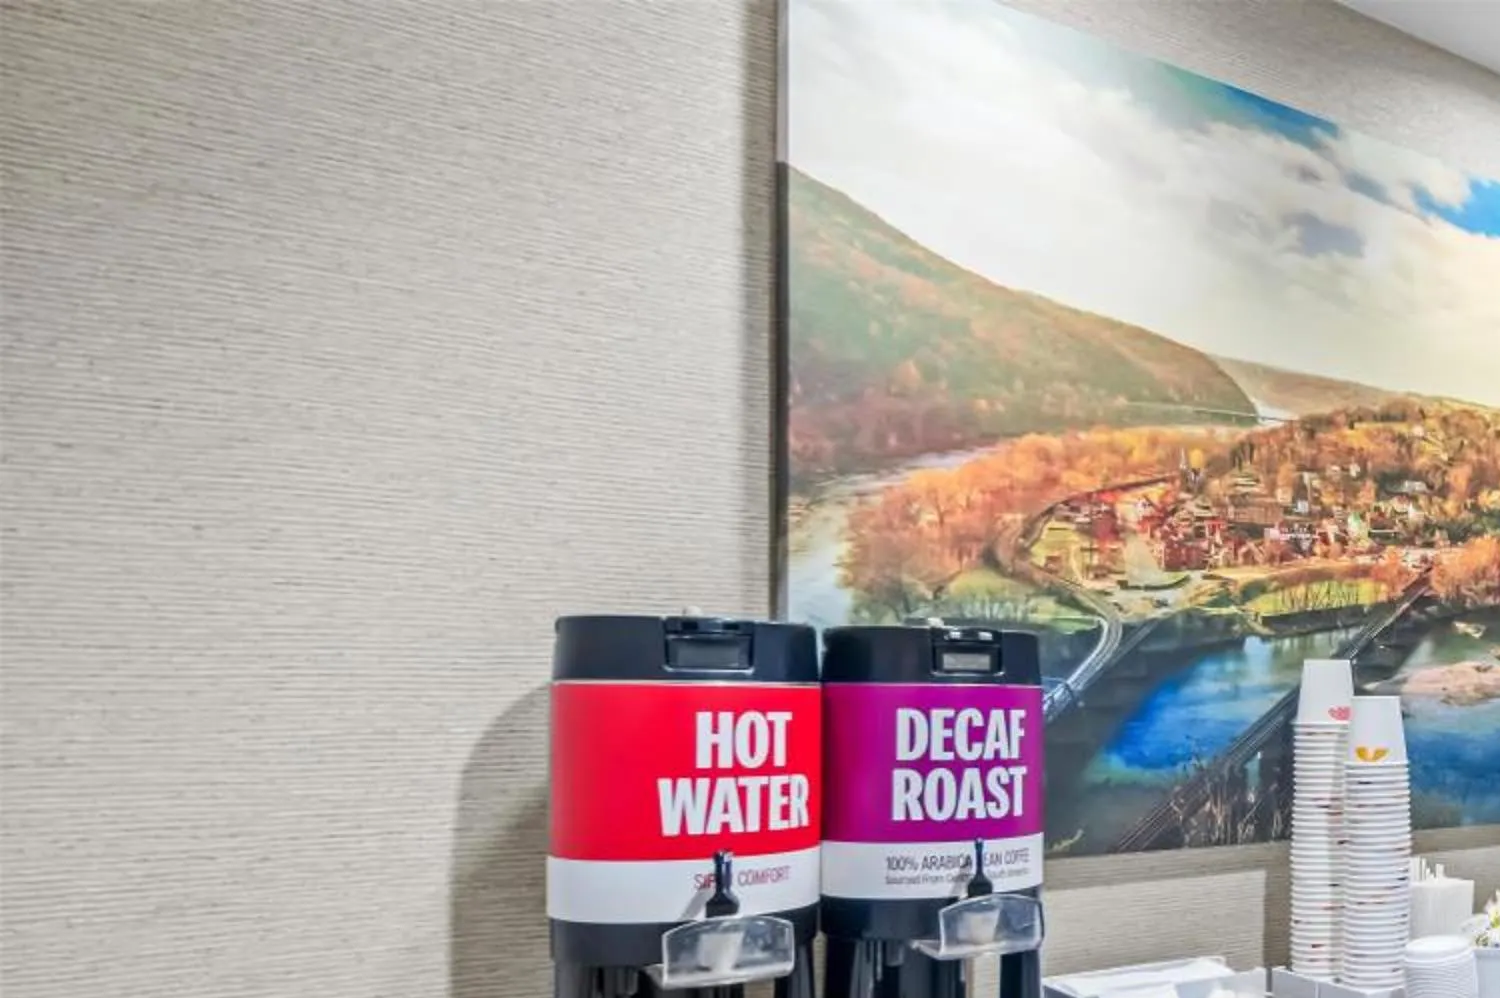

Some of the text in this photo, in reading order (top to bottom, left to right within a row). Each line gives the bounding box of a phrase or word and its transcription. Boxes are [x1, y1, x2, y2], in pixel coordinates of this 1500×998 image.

[696, 711, 792, 769] HOT
[895, 707, 1026, 762] DECAF
[658, 773, 810, 837] WATER
[892, 766, 1027, 823] ROAST
[737, 865, 790, 887] COMFORT
[886, 855, 918, 871] 100%
[920, 853, 972, 870] ARABICA
[983, 850, 1002, 867] EAN
